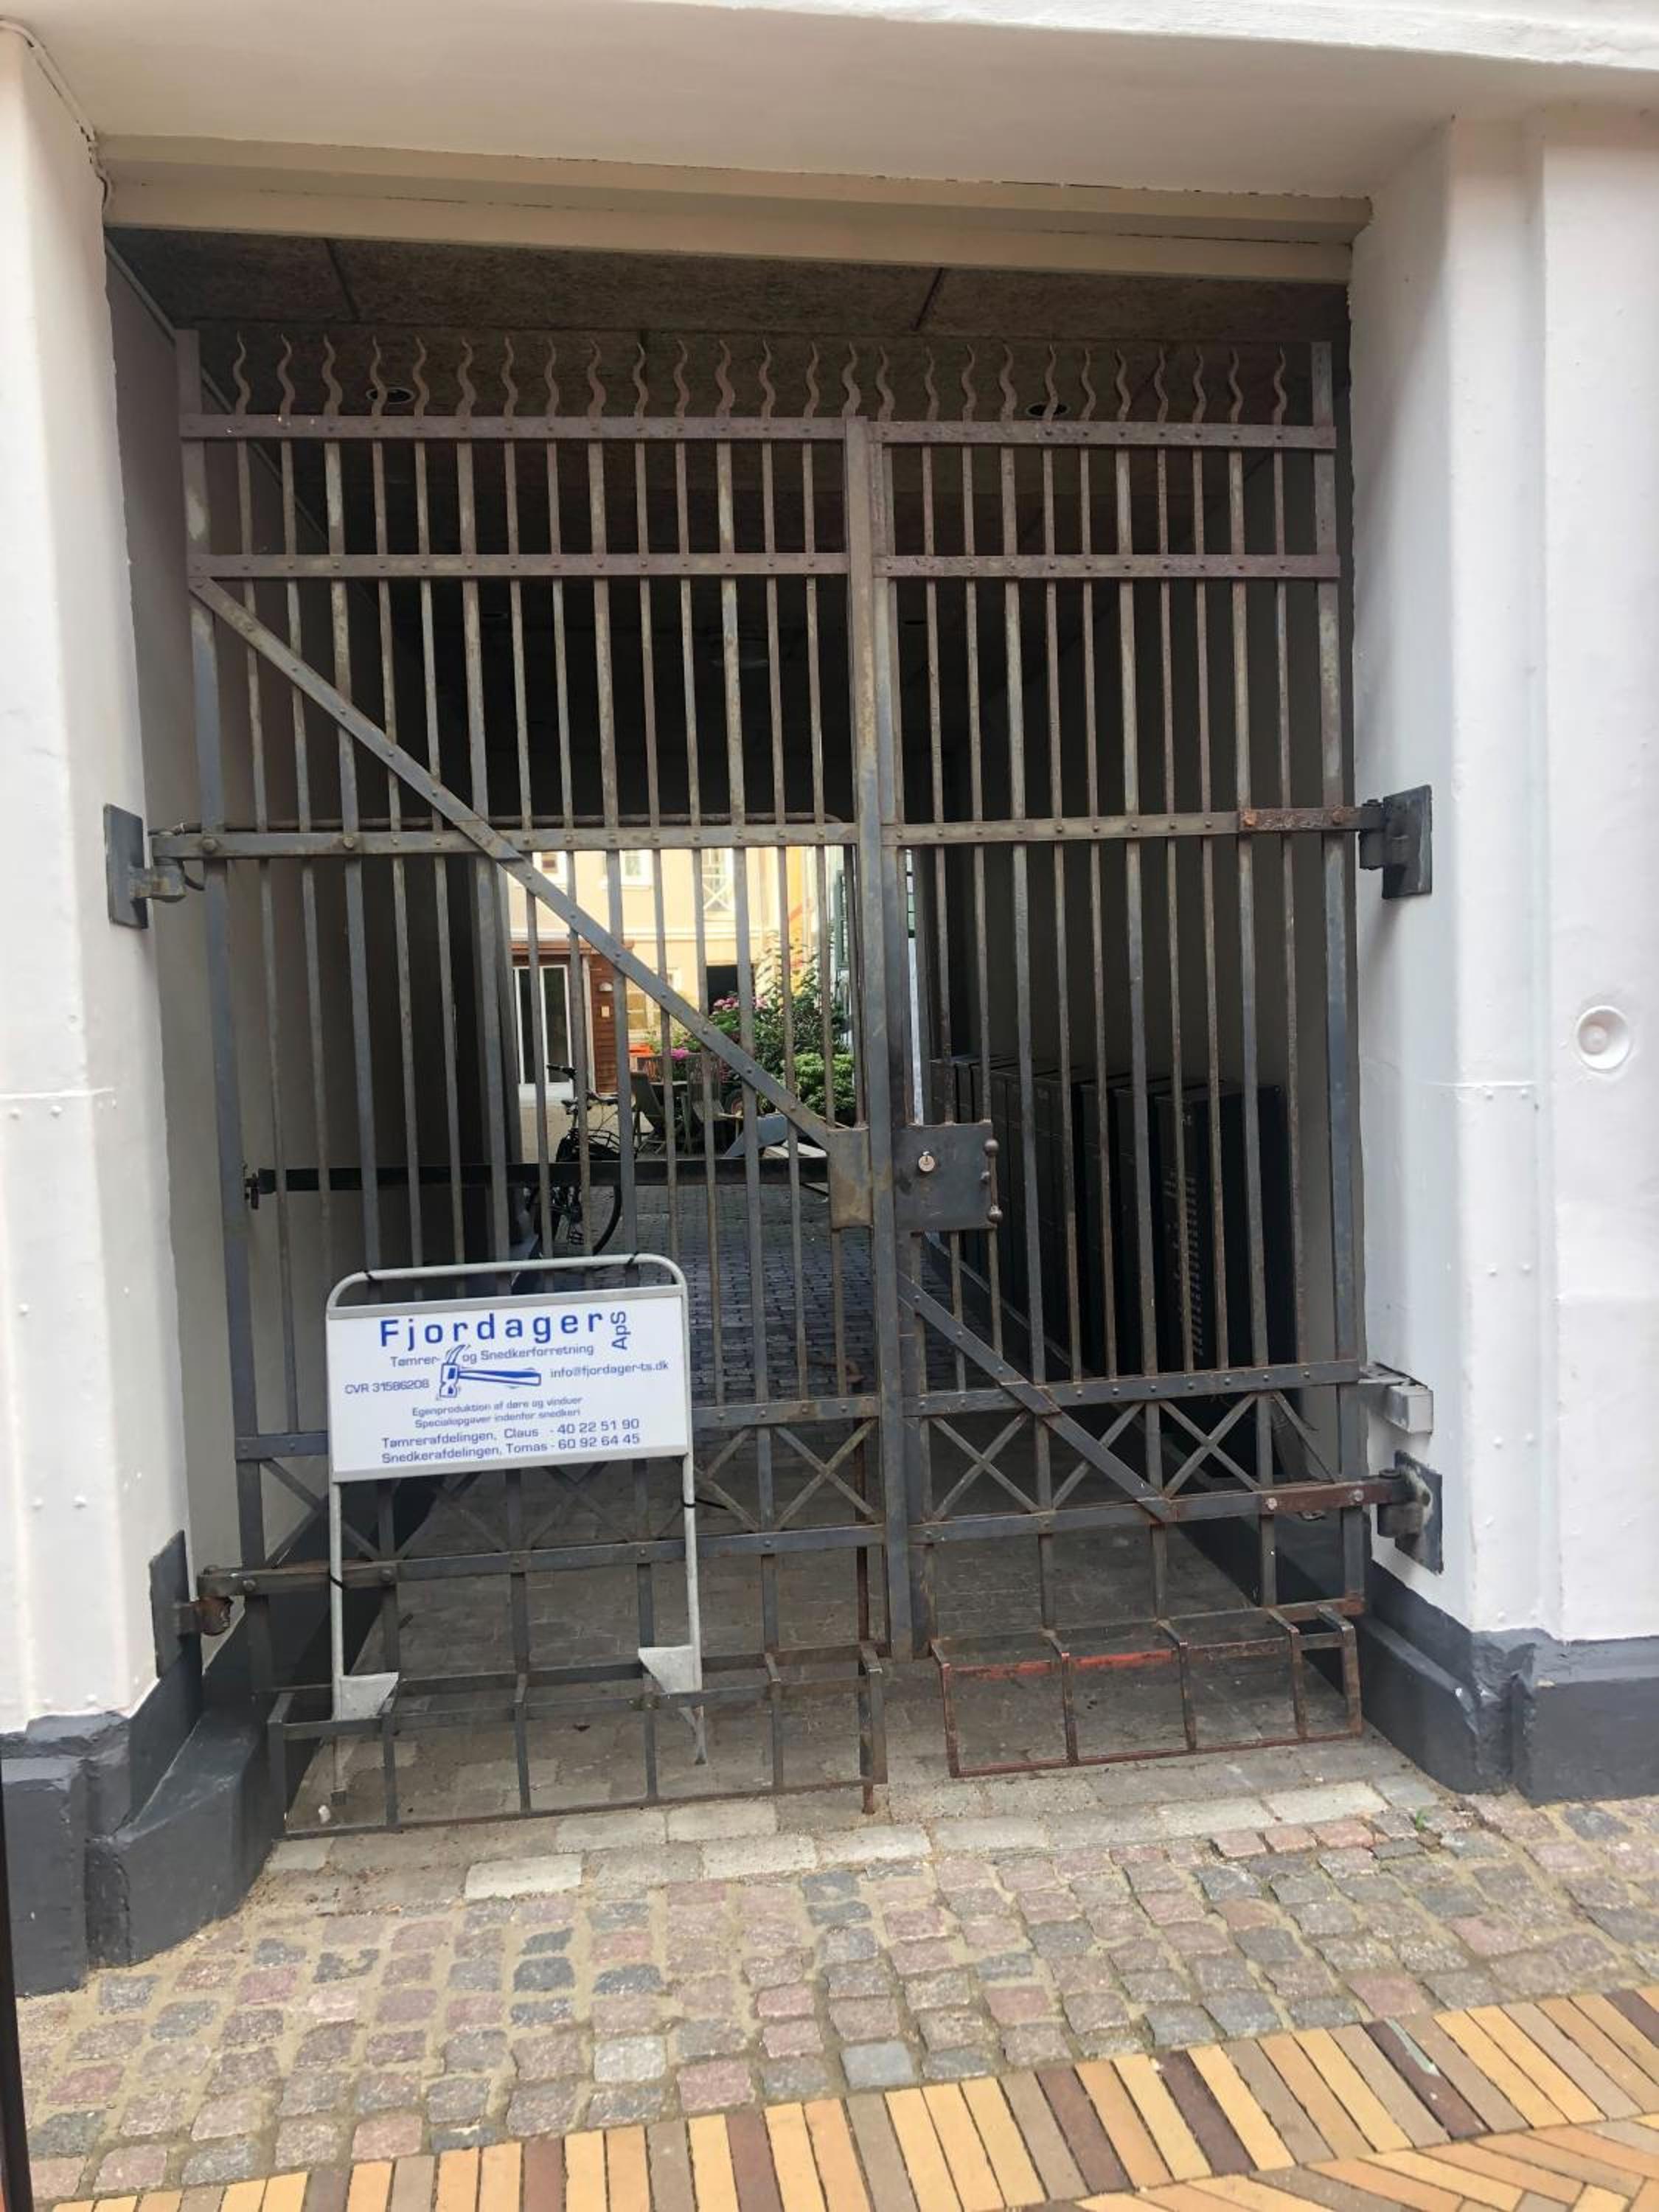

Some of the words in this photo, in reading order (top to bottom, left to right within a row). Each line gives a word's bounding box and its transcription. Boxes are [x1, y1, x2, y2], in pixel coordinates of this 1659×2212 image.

[380, 1312, 603, 1351] Fjordager
[610, 1310, 631, 1350] ApS
[390, 1355, 440, 1367] Tømrer-
[462, 1354, 477, 1364] og
[480, 1345, 594, 1361] Snedkerforretning
[550, 1360, 669, 1378] info@fjordager-ts.dk
[344, 1383, 369, 1394] CVR
[372, 1379, 430, 1393] 31586208
[412, 1404, 491, 1417] Egenproduktion
[494, 1401, 504, 1410] af
[546, 1397, 582, 1405] vinduer
[414, 1415, 490, 1429] Specialopgaver
[494, 1413, 536, 1422] indenfor
[538, 1409, 580, 1419] snedkeri
[382, 1431, 497, 1448] Tømrerafdelingen,
[504, 1428, 539, 1439] Claus
[557, 1424, 575, 1434] 40
[579, 1422, 597, 1433] 22
[601, 1420, 616, 1430] 51
[622, 1418, 639, 1430] 90
[381, 1447, 502, 1464] Snedkerafdelingen,
[507, 1443, 548, 1453] Tomas
[558, 1439, 576, 1450] 60
[580, 1437, 597, 1448] 92
[601, 1436, 619, 1446] 64
[623, 1433, 640, 1444] 45
